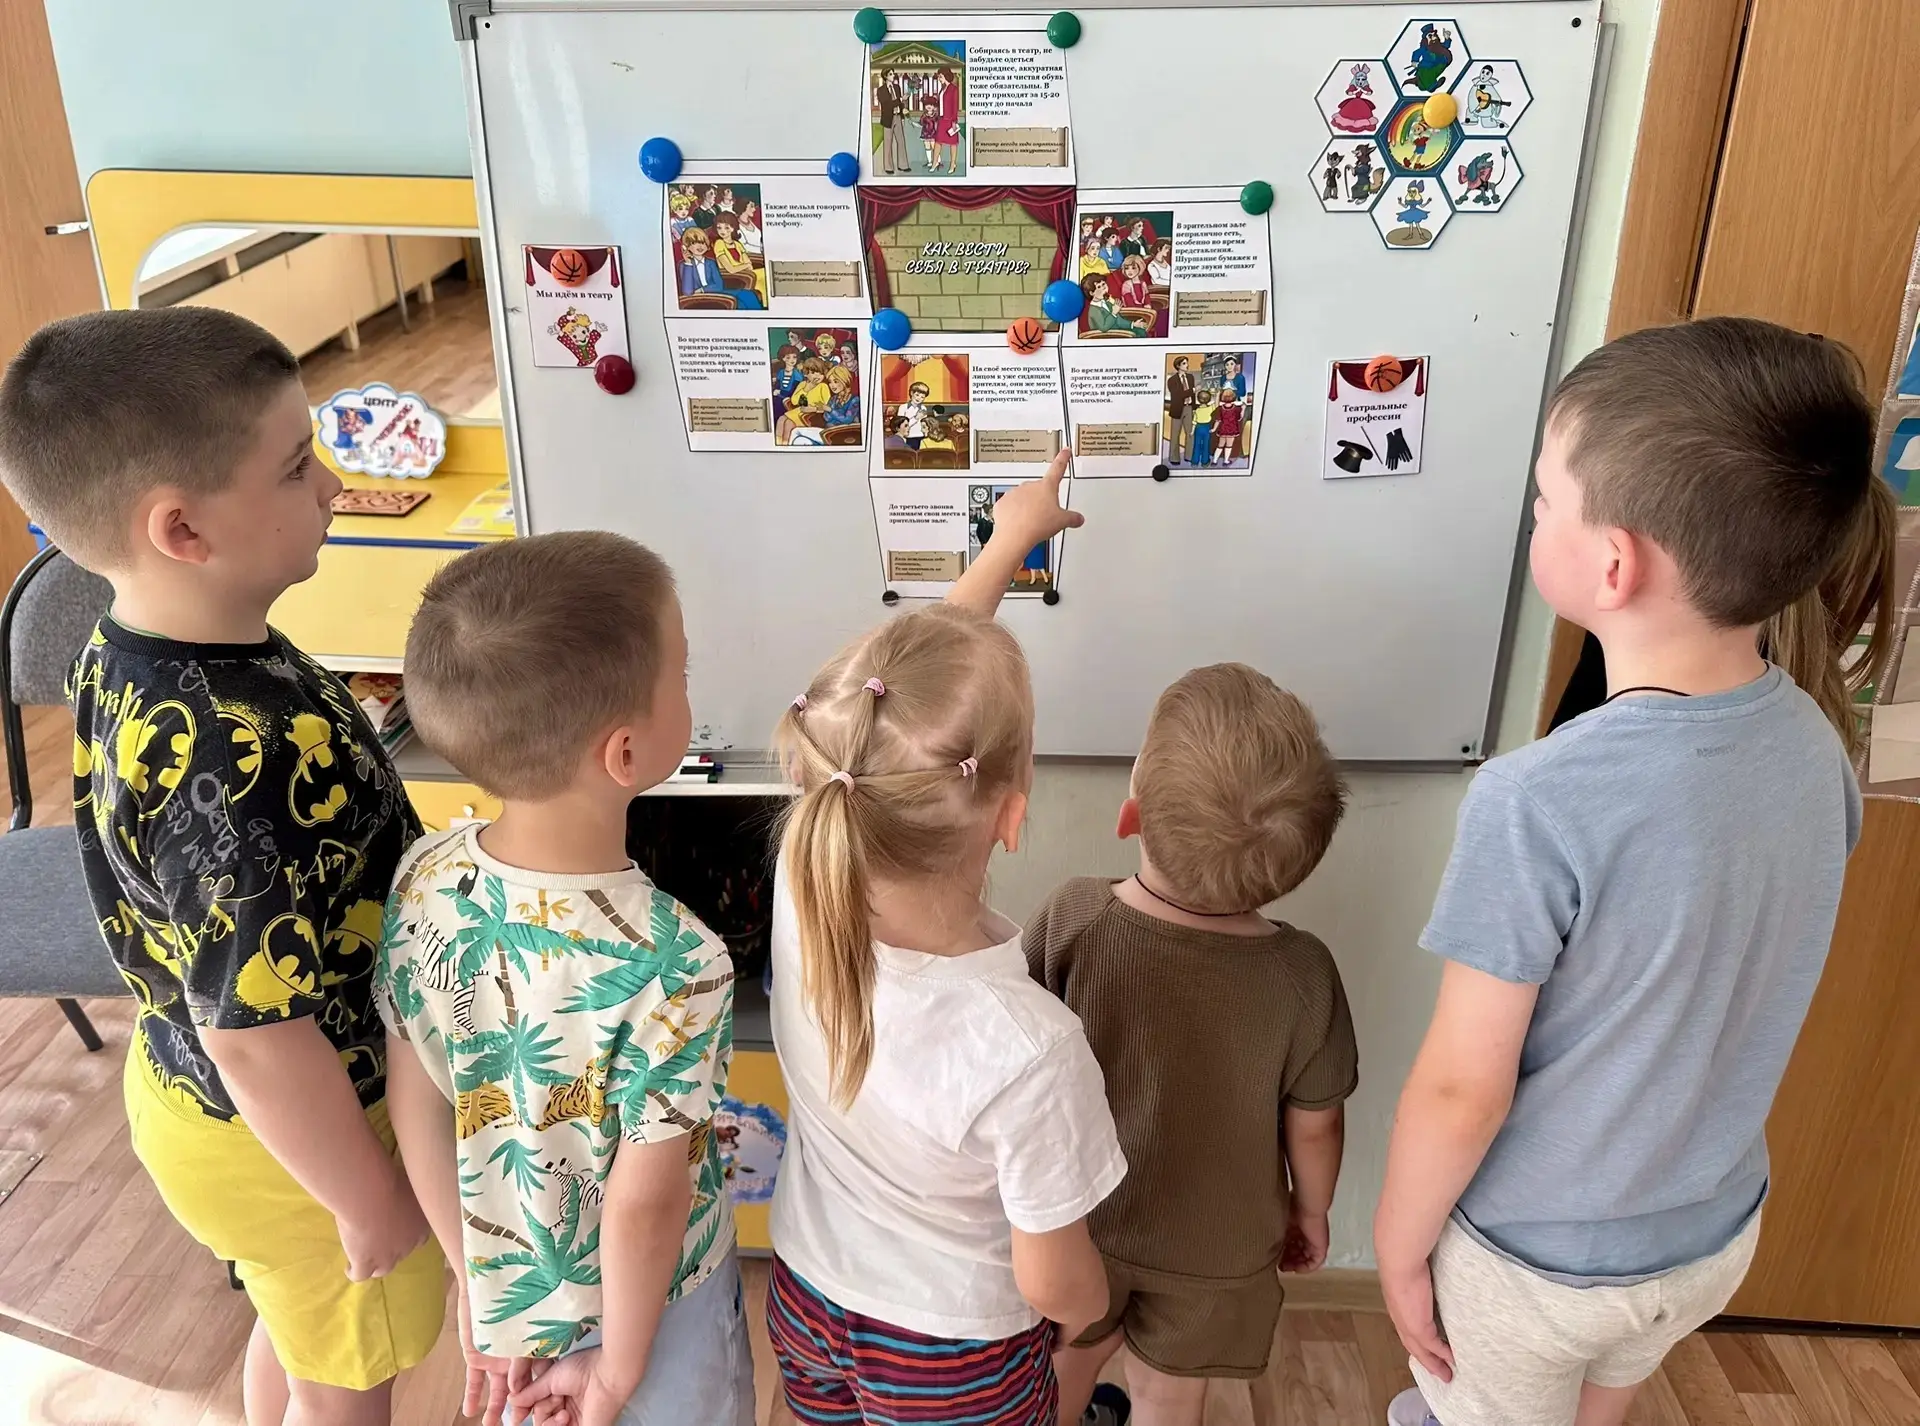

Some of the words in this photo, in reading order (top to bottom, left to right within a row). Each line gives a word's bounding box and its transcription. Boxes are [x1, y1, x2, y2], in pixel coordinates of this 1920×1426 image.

[969, 47, 1010, 55] Собираясь
[922, 241, 953, 256] КАК
[955, 242, 1009, 256] ВЕСТИ
[905, 259, 945, 274] СЕБЯ
[948, 259, 959, 274] В
[964, 259, 1031, 274] ТЕАТРЕ?
[536, 289, 552, 297] Мы
[555, 290, 578, 298] идём
[587, 292, 613, 300] театр
[364, 396, 398, 408] ЦЕНТР
[1342, 403, 1408, 412] Театральные
[1347, 413, 1401, 423] профессии
